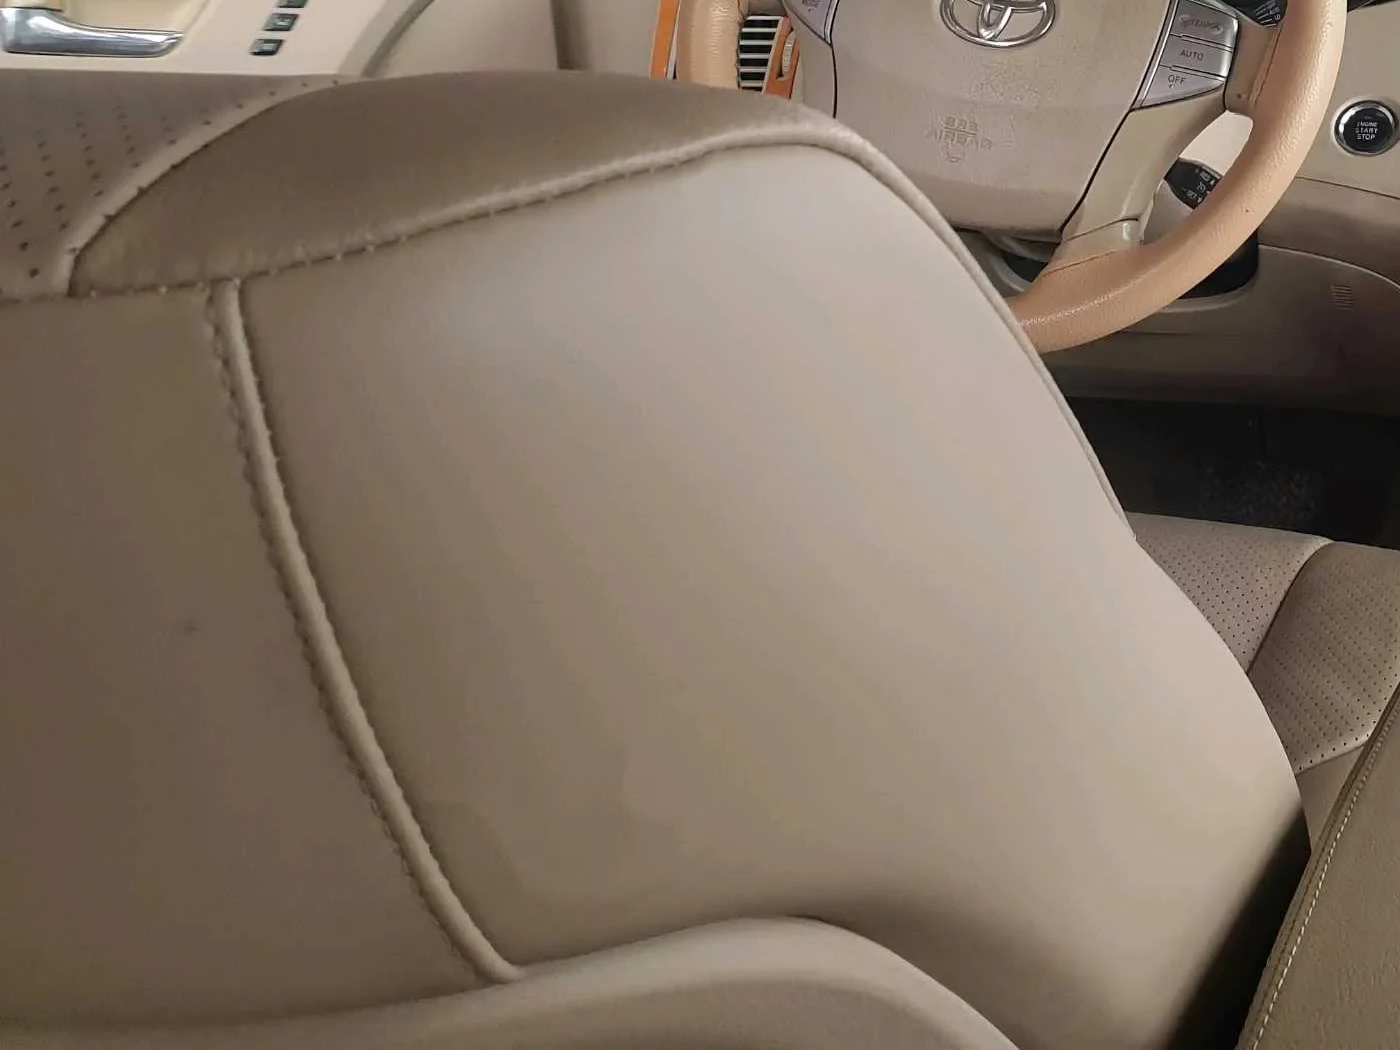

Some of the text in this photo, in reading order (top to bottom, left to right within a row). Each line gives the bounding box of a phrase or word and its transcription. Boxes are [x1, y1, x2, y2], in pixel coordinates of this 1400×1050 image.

[1179, 49, 1205, 62] AUTO
[1167, 74, 1188, 85] OFF
[1356, 133, 1376, 141] STOP
